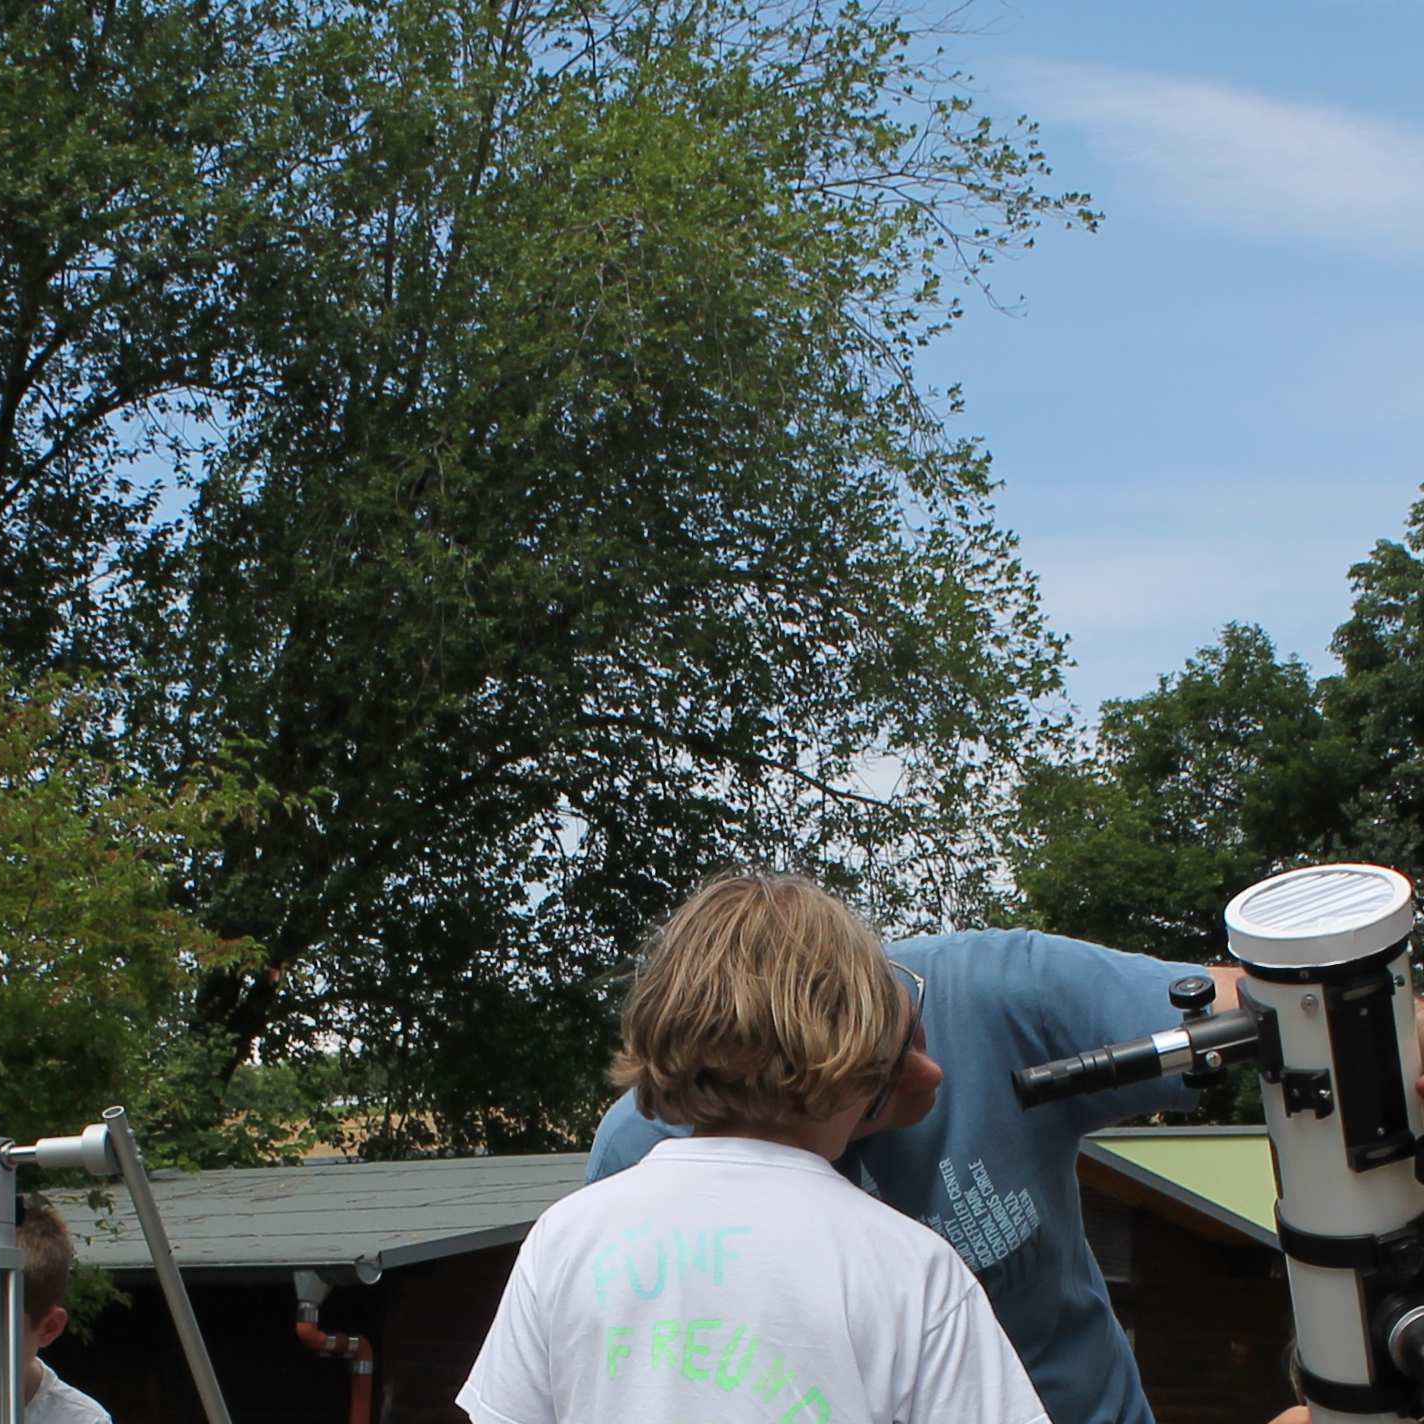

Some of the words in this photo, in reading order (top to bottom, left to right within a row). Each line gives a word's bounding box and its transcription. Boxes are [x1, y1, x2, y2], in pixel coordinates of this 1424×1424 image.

[938, 1157, 962, 1201] CENTER
[968, 1157, 995, 1197] CIRCLE
[964, 1186, 986, 1217] PARK
[986, 1194, 1021, 1251] COLUMBUS
[1003, 1189, 1024, 1226] PLAZA
[943, 1217, 964, 1242] CITY
[952, 1200, 997, 1268] ROCKEFELLER
[979, 1213, 1009, 1260] CENTRAL
[592, 1216, 753, 1312] FÜNF
